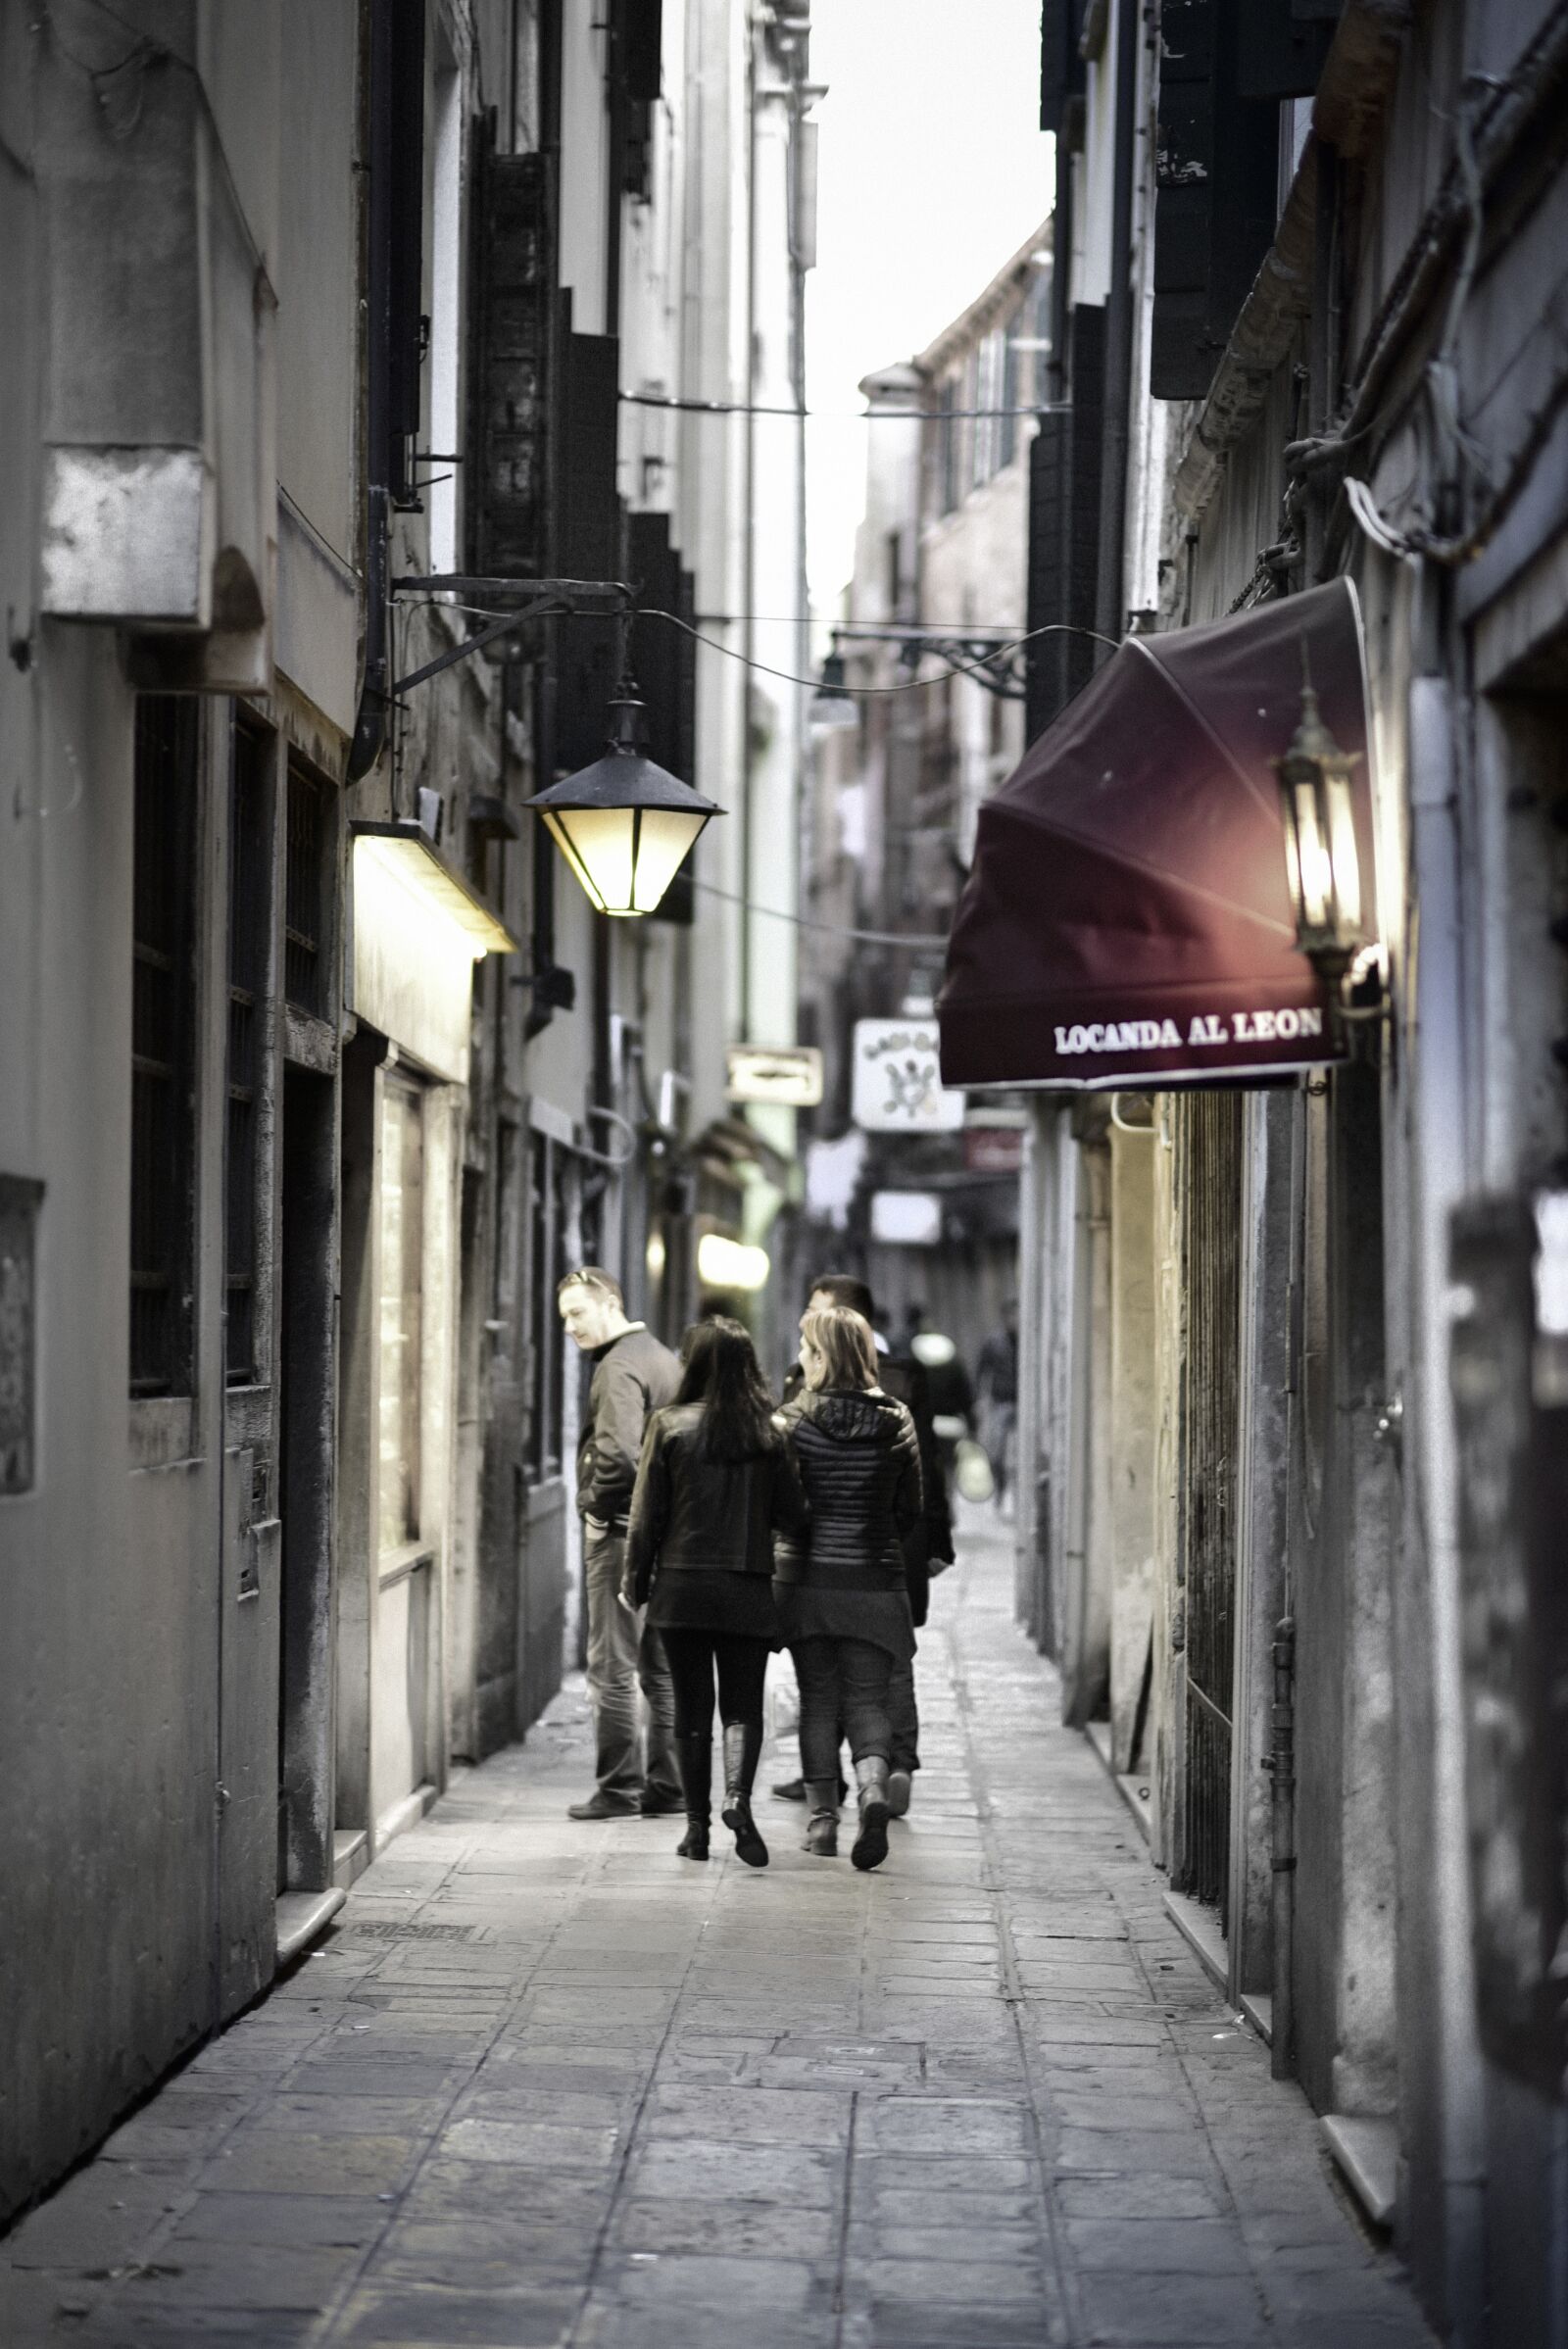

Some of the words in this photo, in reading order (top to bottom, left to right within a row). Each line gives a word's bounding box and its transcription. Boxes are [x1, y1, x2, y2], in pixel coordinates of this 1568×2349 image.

[1054, 1019, 1182, 1054] LOCANDA
[1188, 1013, 1229, 1046] AL
[1233, 1007, 1323, 1043] LEON
